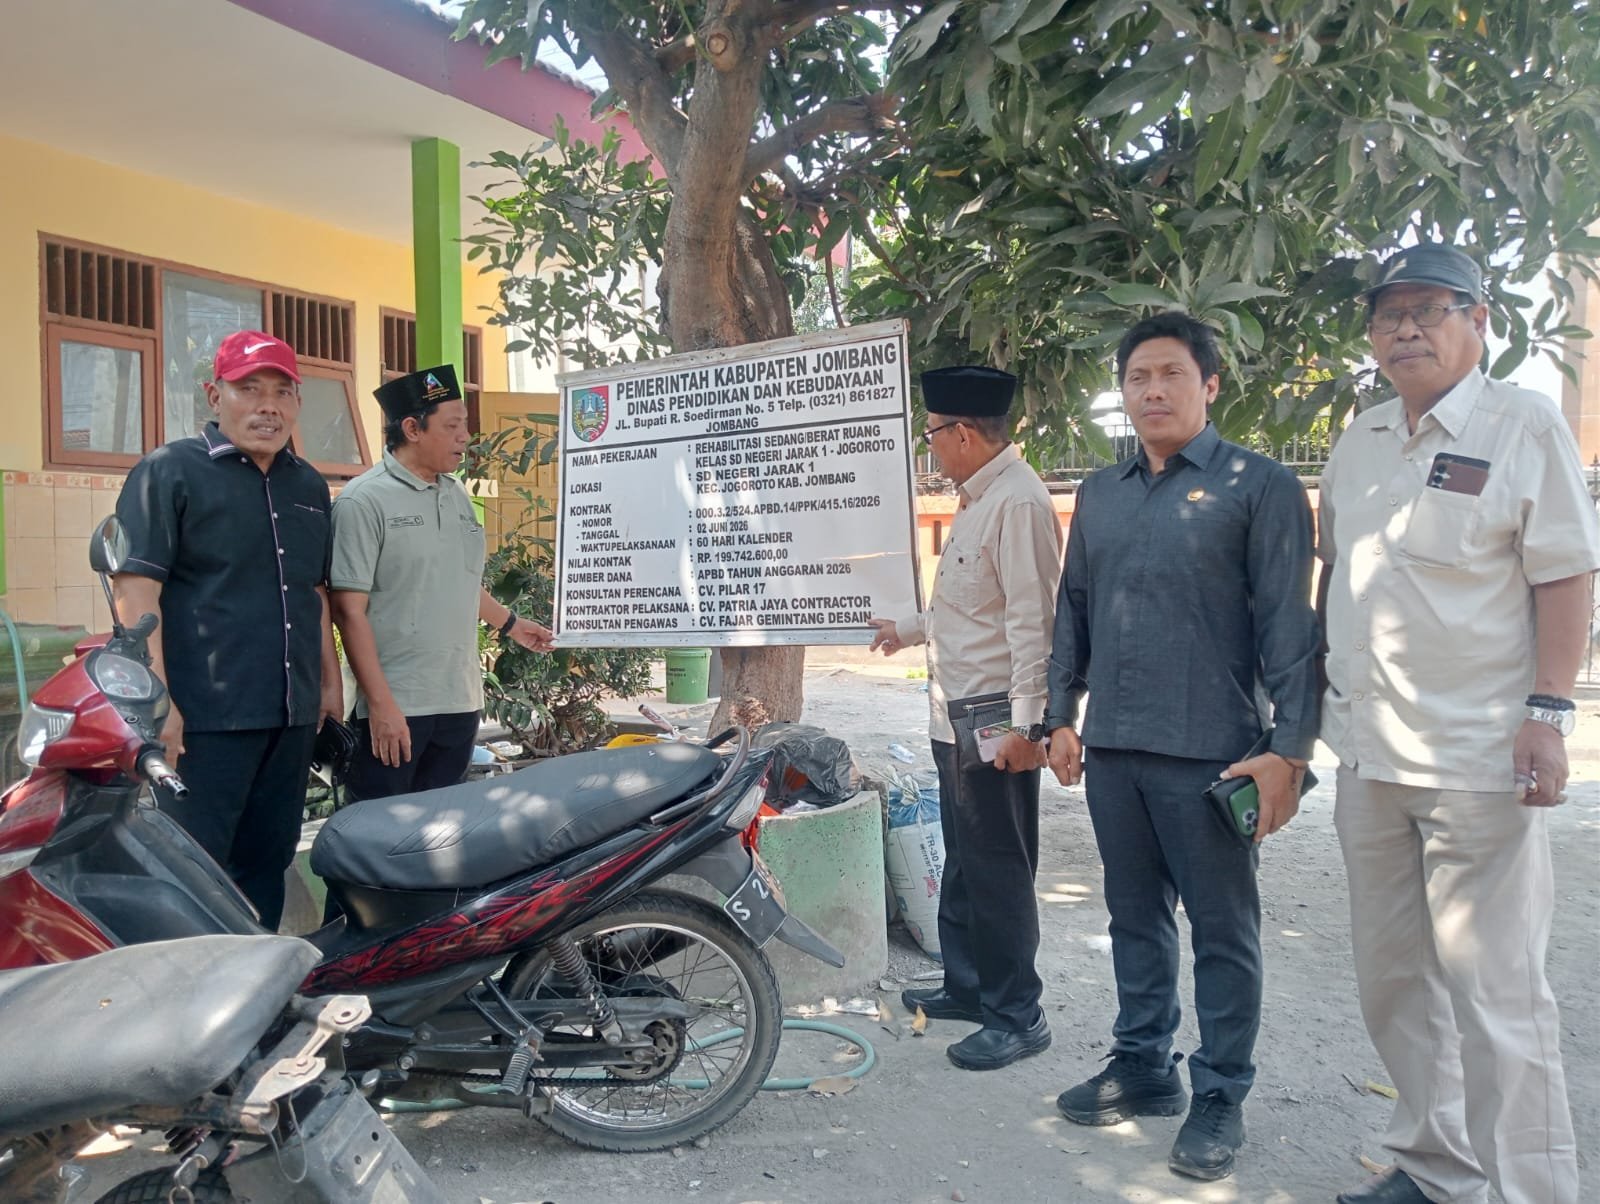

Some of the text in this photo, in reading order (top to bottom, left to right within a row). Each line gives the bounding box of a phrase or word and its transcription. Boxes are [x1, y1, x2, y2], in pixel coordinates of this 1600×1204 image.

[616, 342, 897, 401] PEMERINTAH KABUPATEN JOMBANG
[627, 368, 884, 416] DINAS PENDIDIKAN DAN KEBUDAYAAN
[615, 386, 896, 430] JL. Bupati R. Soedirman No. 5 Telp. (0321) 861827
[706, 417, 759, 433] JOMBANG
[696, 439, 762, 454] REHABILITASI
[764, 429, 840, 447] SEDANG/BERAT
[843, 425, 880, 439] RUANG
[572, 448, 657, 467] NAMA PEKERJAAN
[695, 455, 727, 468] KELAS
[730, 453, 742, 465] SD
[745, 448, 782, 464] NEGERI
[785, 445, 819, 460] JARAK
[822, 445, 827, 457] 1
[837, 439, 895, 455] JOGOROTO
[696, 470, 712, 482] SD
[715, 466, 760, 480] NEGERI
[764, 463, 805, 477] JARAK
[809, 462, 814, 473] 1
[570, 482, 602, 494] LOKASI
[778, 477, 802, 489] KAB.
[805, 472, 856, 487] JOMBANG
[570, 504, 612, 516] KONTRAK
[582, 517, 612, 528] NOMOR
[697, 523, 706, 534] 02
[709, 522, 727, 533] JUNI
[730, 521, 748, 532] 2026
[581, 530, 620, 540] TANGGAL
[697, 537, 708, 547] 60
[711, 535, 735, 547] HARI
[738, 531, 793, 545] KALENDER
[568, 556, 632, 568] NILAI KONTAK
[697, 552, 712, 564] RP.
[715, 549, 788, 562] 199.742.600,00
[568, 572, 632, 583] SUMBER DANA
[698, 568, 724, 580] APBD
[728, 566, 762, 579] TAHUN
[764, 563, 824, 577] ANGGARAN
[826, 563, 851, 574] 2026
[566, 586, 681, 600] KONSULTAN PERENCANA
[699, 584, 715, 597] CV.
[718, 584, 750, 595] PILAR
[753, 583, 766, 594] 17
[566, 603, 689, 616] KONTRAKTOR PELAKSANA
[700, 600, 716, 612] CV.
[718, 599, 757, 612] PATRIA
[760, 598, 788, 611] JAYA
[791, 596, 871, 609] CONTRACTOR
[566, 618, 678, 630] KONSULTAN PENGAWAS
[700, 615, 716, 627] CV.
[719, 615, 753, 626] FAJAR
[757, 612, 825, 626] GEMINTANG
[829, 611, 871, 624] DESAIN
[732, 901, 751, 920] S
